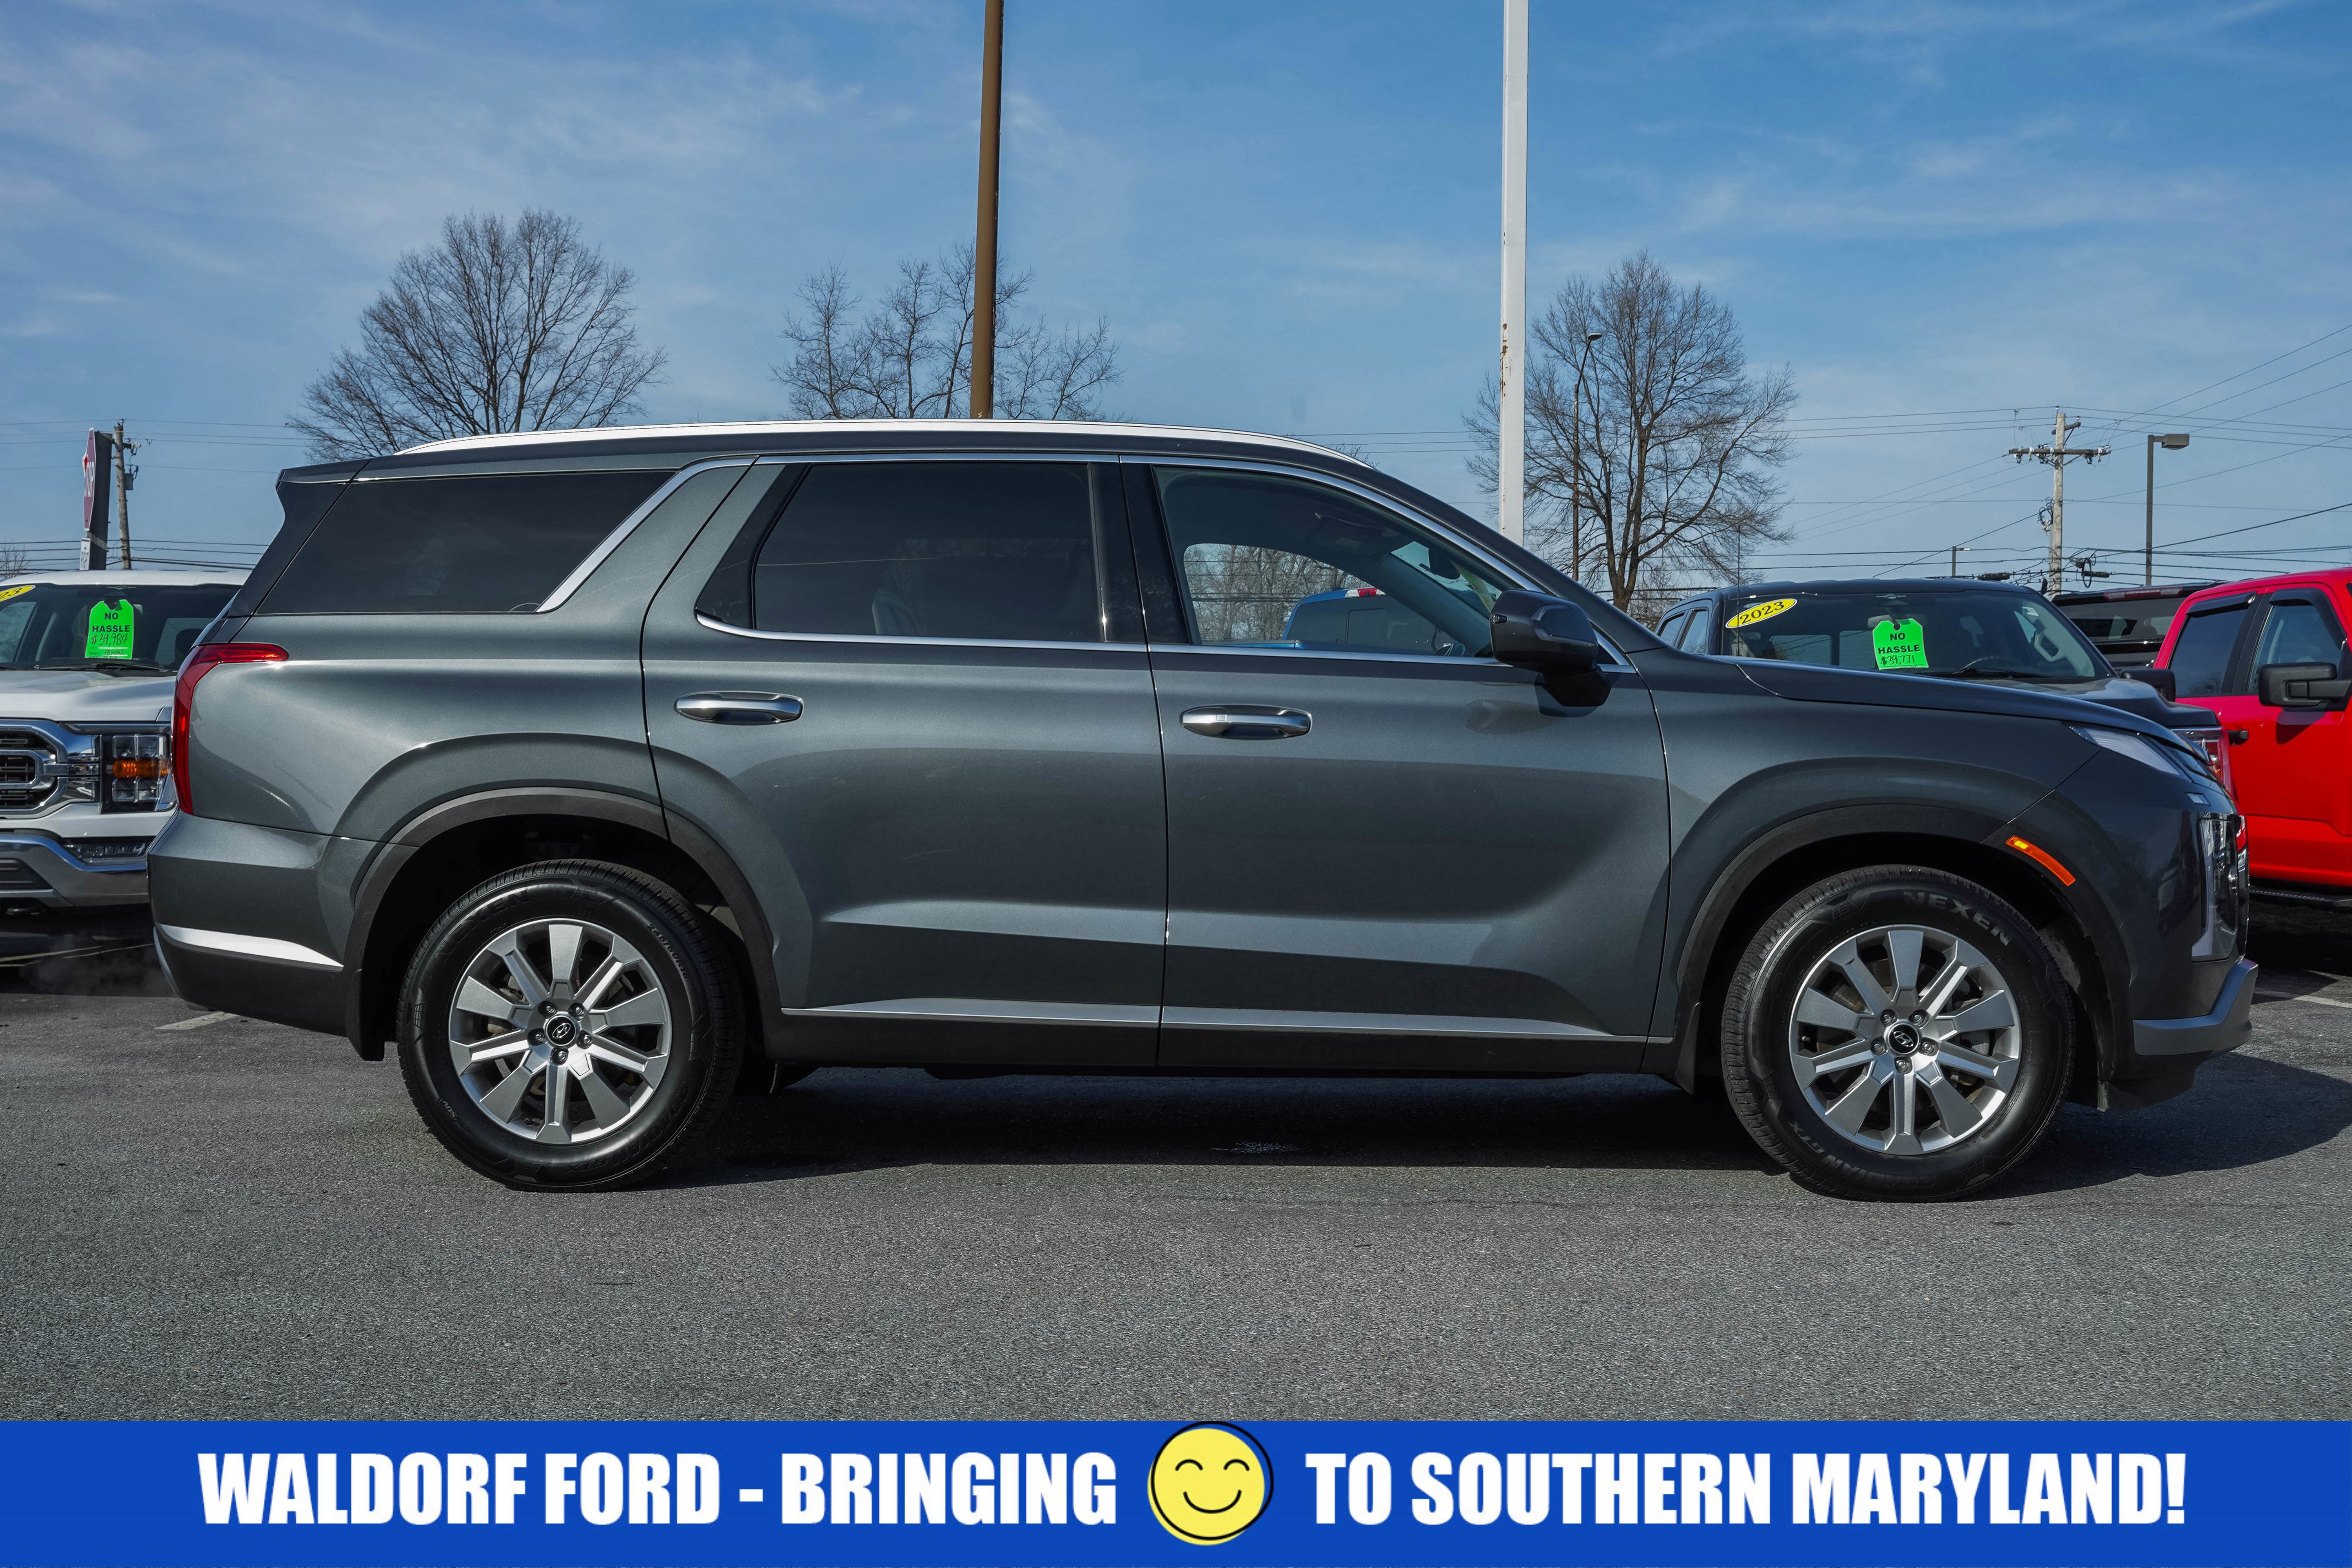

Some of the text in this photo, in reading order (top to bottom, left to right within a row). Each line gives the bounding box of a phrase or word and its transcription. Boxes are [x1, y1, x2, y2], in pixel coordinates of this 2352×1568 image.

[1740, 601, 1784, 624] 2023
[1878, 644, 1921, 654] HASSLE
[1880, 655, 1915, 666] $39,771
[1902, 890, 2015, 948] NEXEN
[440, 1097, 459, 1120] SUV
[1787, 1117, 1827, 1157] GTX
